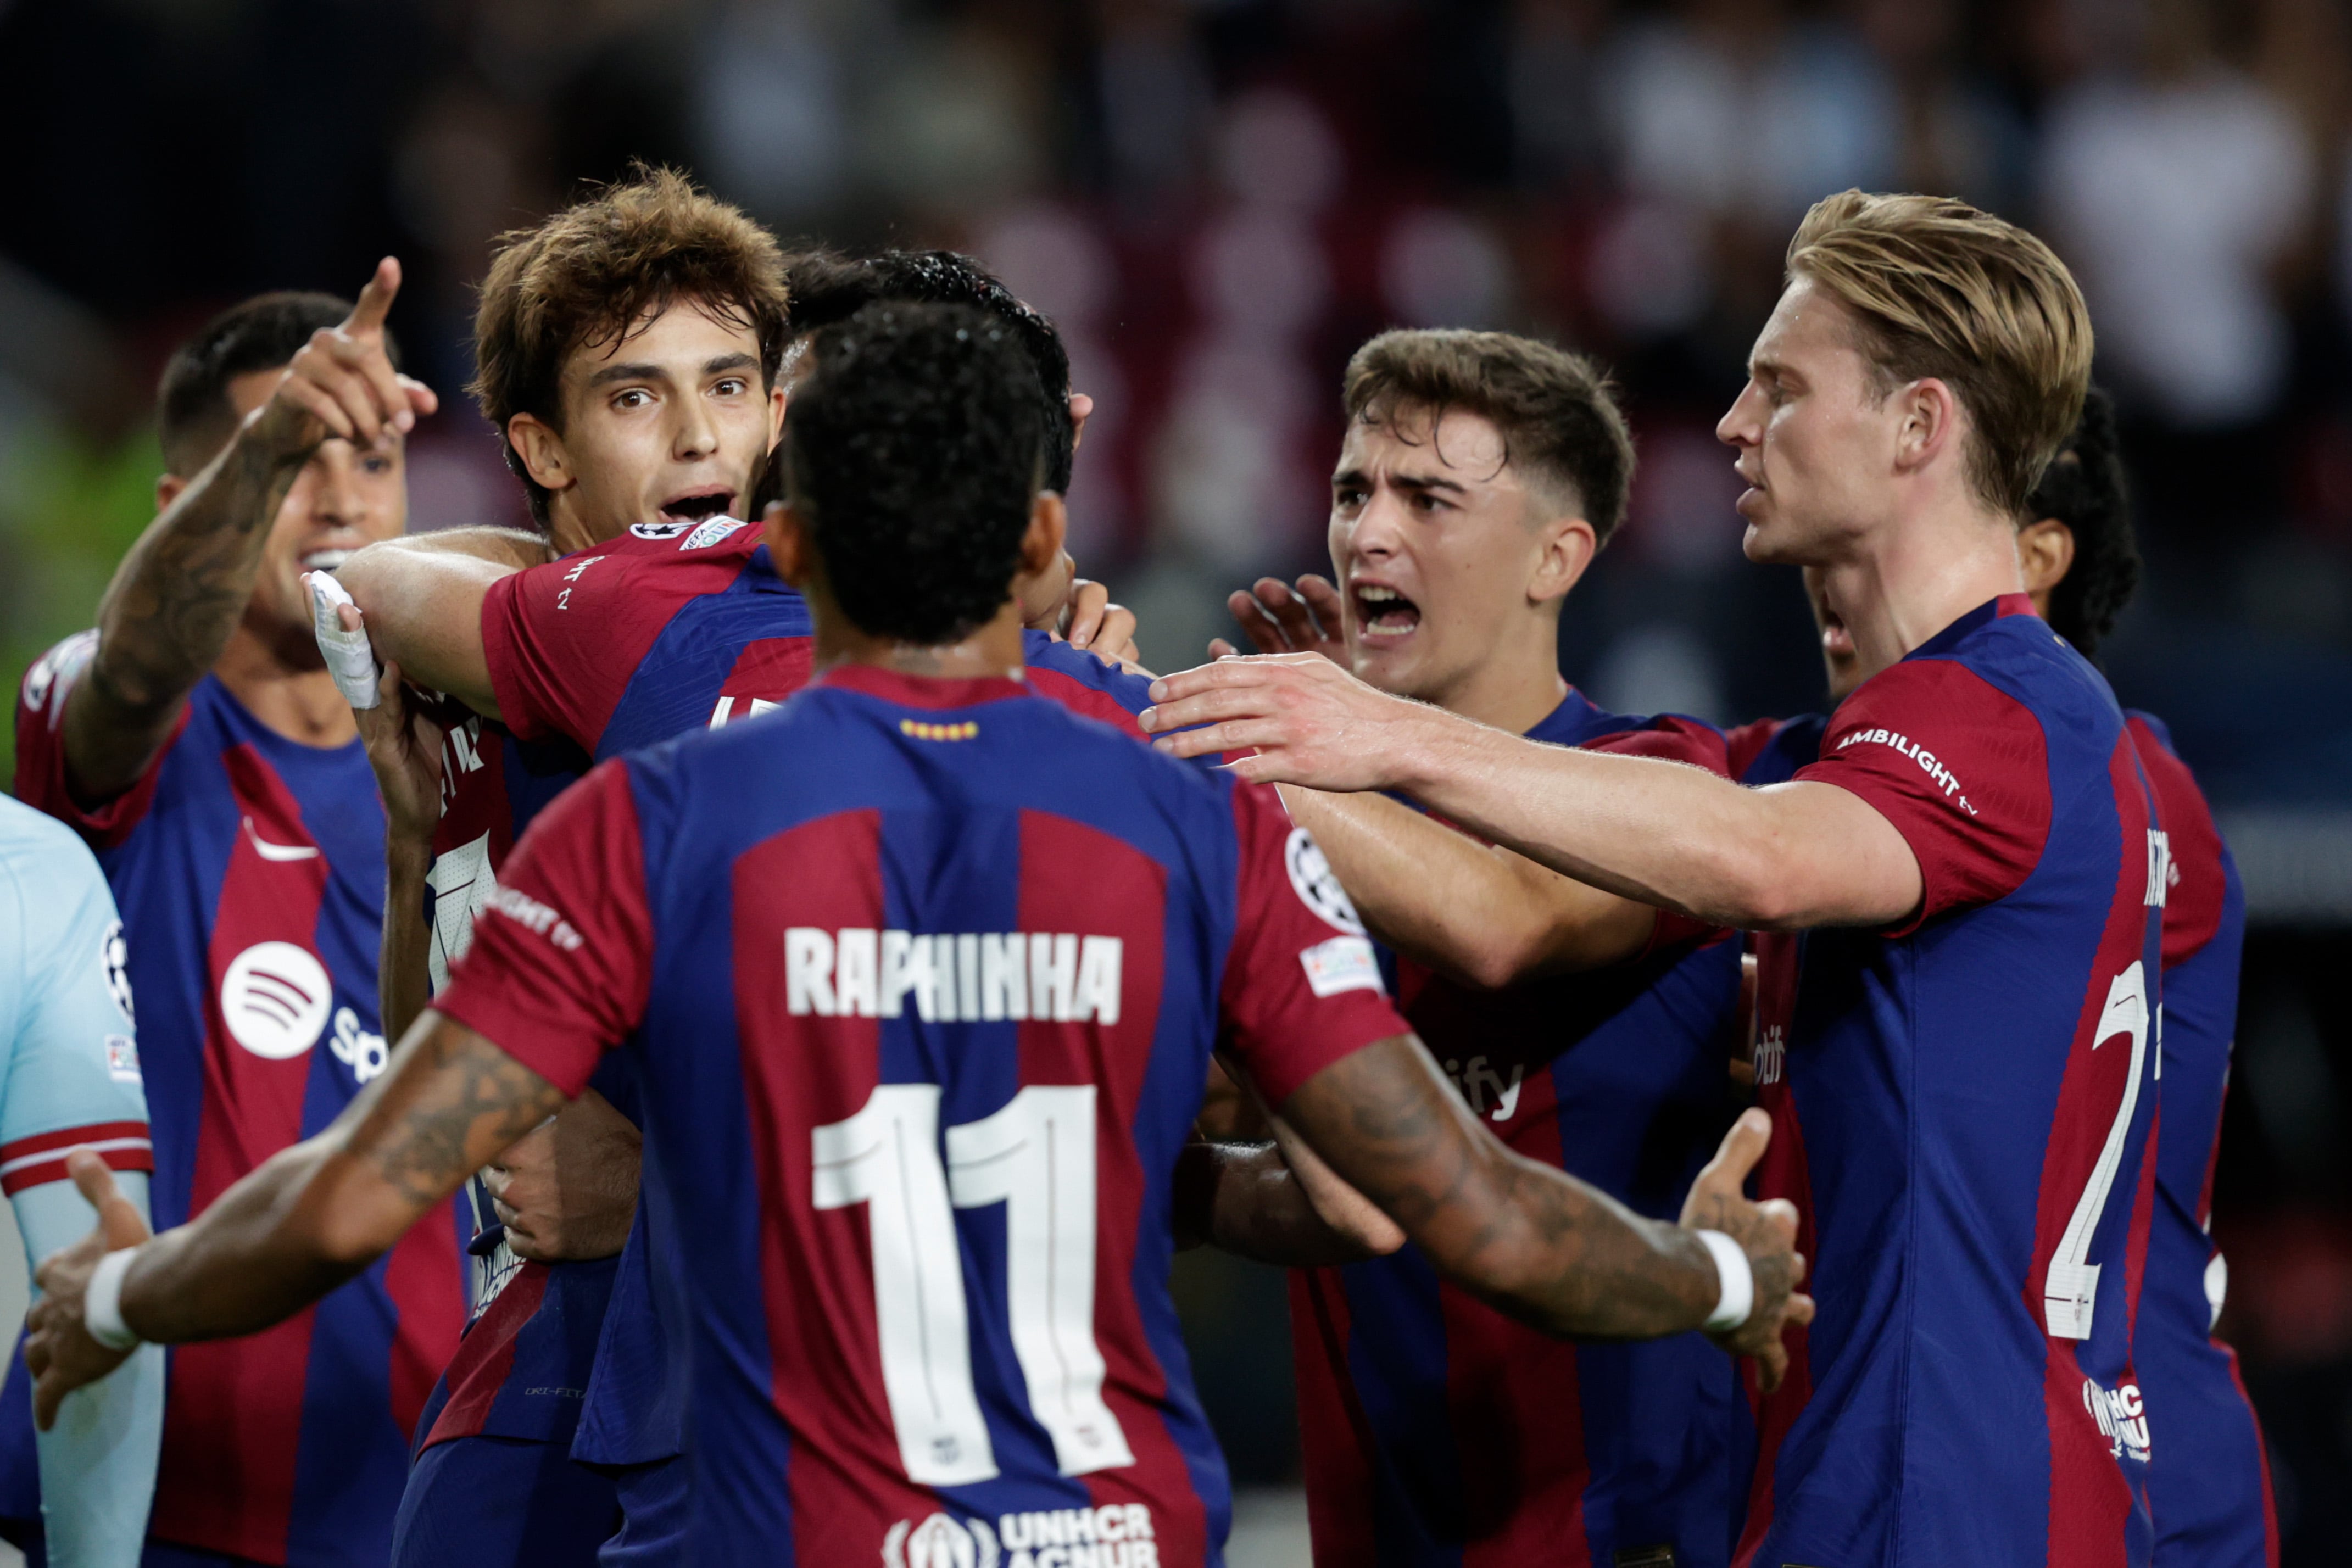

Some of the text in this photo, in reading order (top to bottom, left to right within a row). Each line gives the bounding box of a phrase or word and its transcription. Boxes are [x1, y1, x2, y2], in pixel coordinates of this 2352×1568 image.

[1836, 729, 1978, 816] AMBILIGHT tv
[784, 927, 1123, 1025] RAPHINHA
[811, 1083, 1136, 1486] 11
[999, 1503, 1156, 1552] UNHCR
